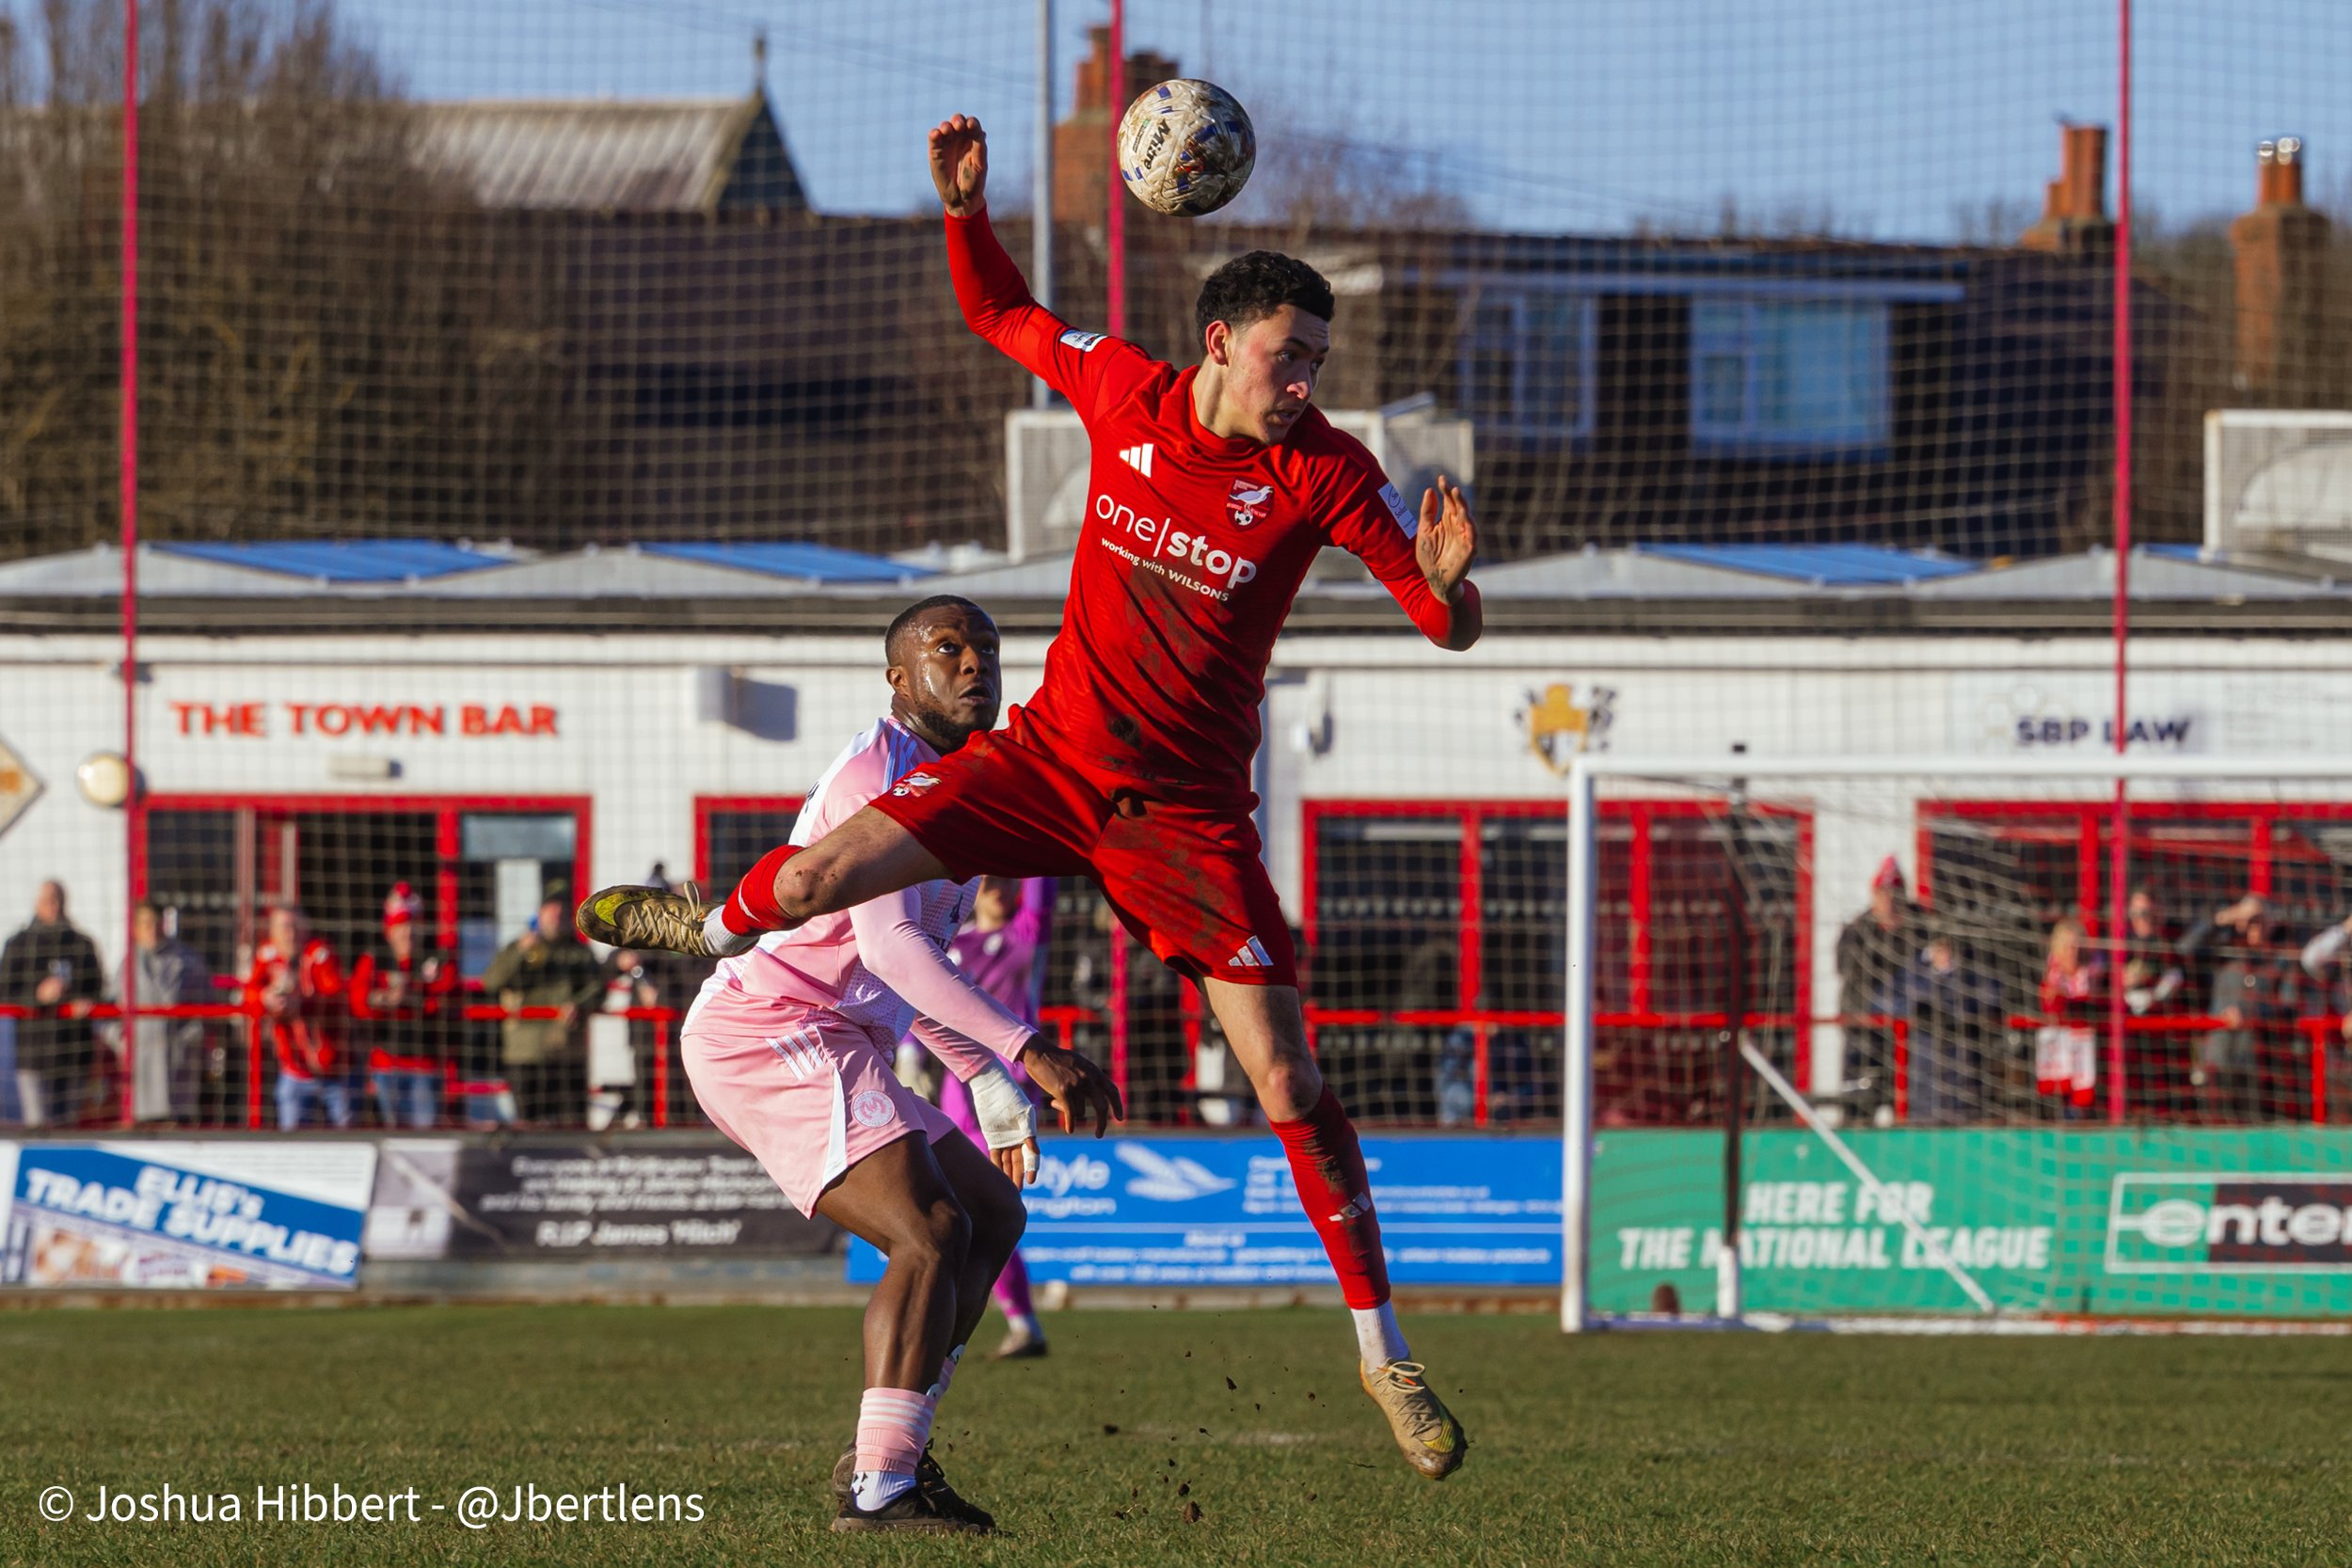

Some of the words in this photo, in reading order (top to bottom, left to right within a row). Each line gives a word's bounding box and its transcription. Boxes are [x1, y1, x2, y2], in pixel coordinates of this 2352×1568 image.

[1102, 537, 1140, 566] working
[1142, 560, 1166, 576] with
[1168, 569, 1230, 602] WILSONS
[169, 701, 265, 738] THE
[284, 702, 445, 737] TOWN
[460, 704, 559, 736] BAR
[2016, 717, 2090, 746] SBP
[2103, 718, 2190, 743] LAW
[26, 1166, 163, 1228] TRADE
[163, 1202, 360, 1276] SUPPLIES
[1745, 1180, 1848, 1225] HERE
[1853, 1180, 1934, 1225] FOR
[593, 1221, 669, 1246] James
[1617, 1227, 1694, 1271] THE
[1698, 1227, 1892, 1271] NATIONAL
[1901, 1227, 2053, 1271] LEAGUE
